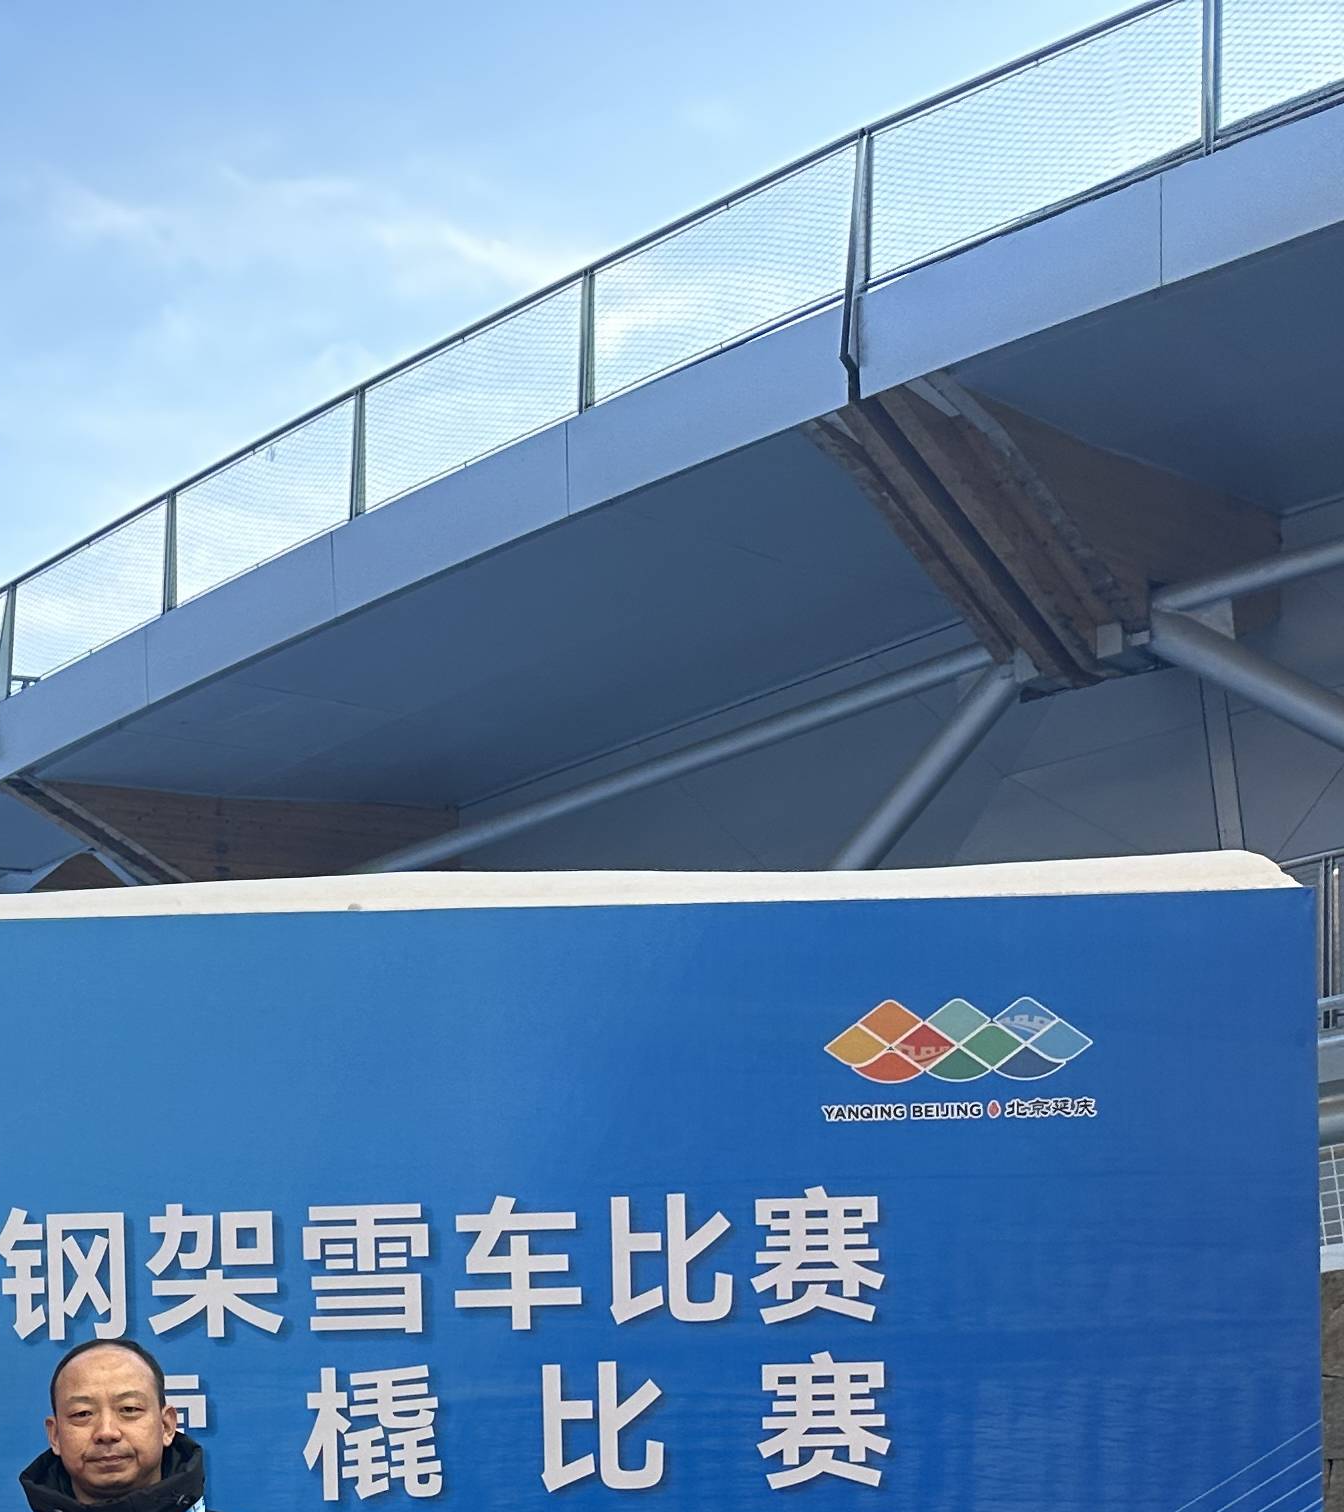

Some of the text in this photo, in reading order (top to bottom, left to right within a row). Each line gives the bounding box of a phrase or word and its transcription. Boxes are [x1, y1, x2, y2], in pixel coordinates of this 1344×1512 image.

[824, 1103, 982, 1121] YANQING BEIJING
[1005, 1098, 1096, 1117] 北京延庆
